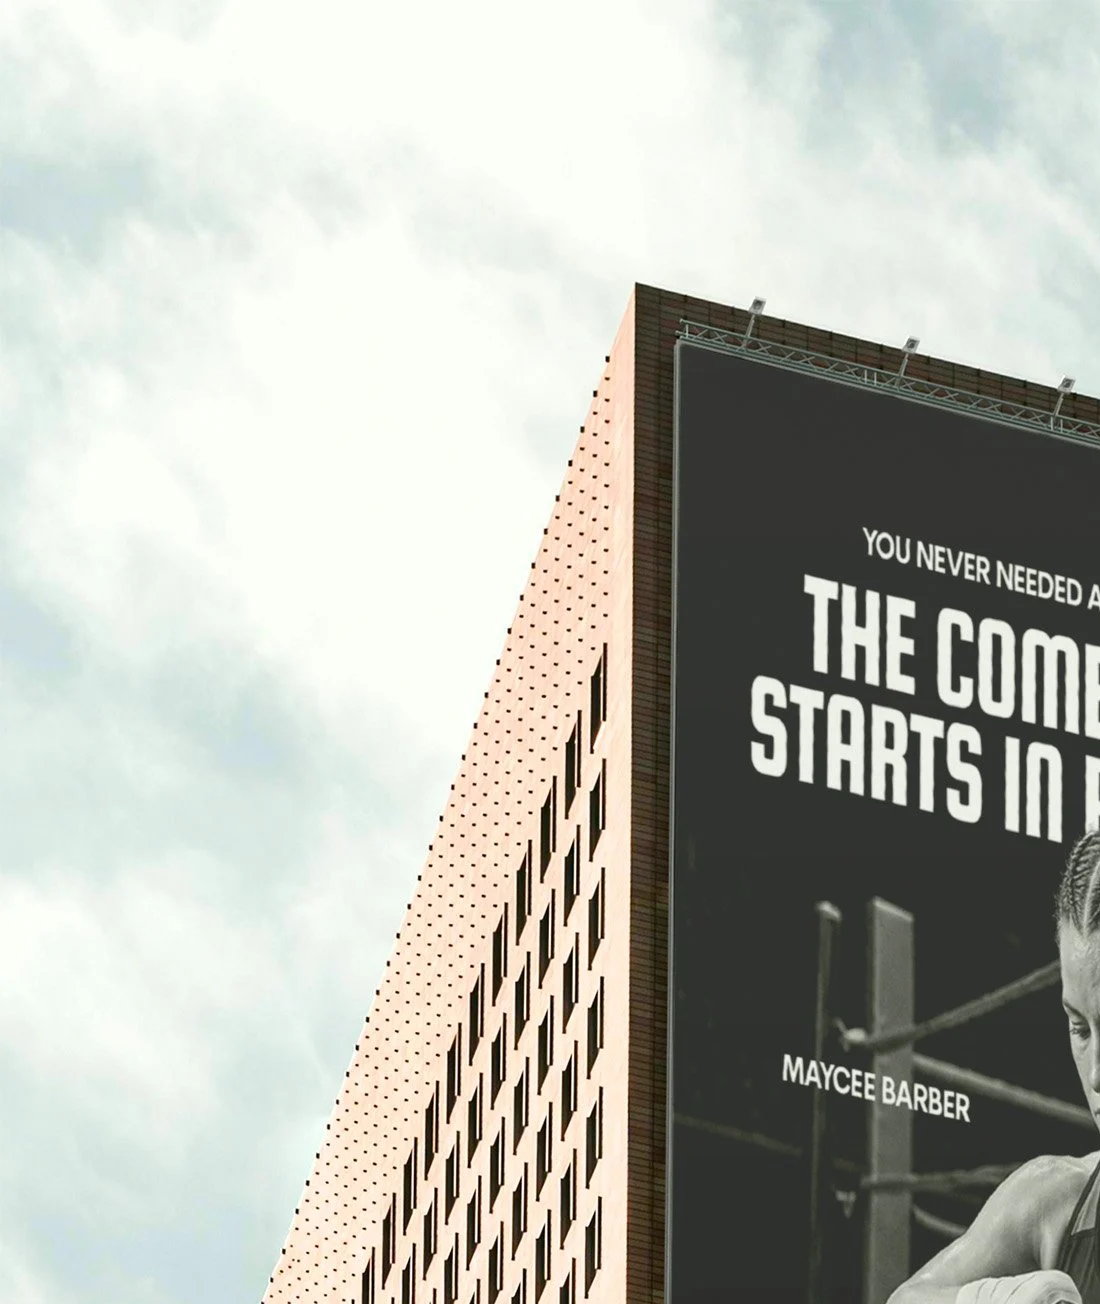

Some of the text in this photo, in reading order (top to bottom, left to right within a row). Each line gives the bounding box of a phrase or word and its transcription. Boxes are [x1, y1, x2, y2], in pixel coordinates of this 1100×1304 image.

[862, 527, 911, 565] YOU
[916, 541, 991, 585] NEVER
[996, 560, 1083, 606] NEEDED
[804, 574, 916, 695] THE
[751, 675, 982, 823] STARTS
[1005, 736, 1062, 843] IN
[782, 1053, 970, 1123] MAYCEE BARBER
